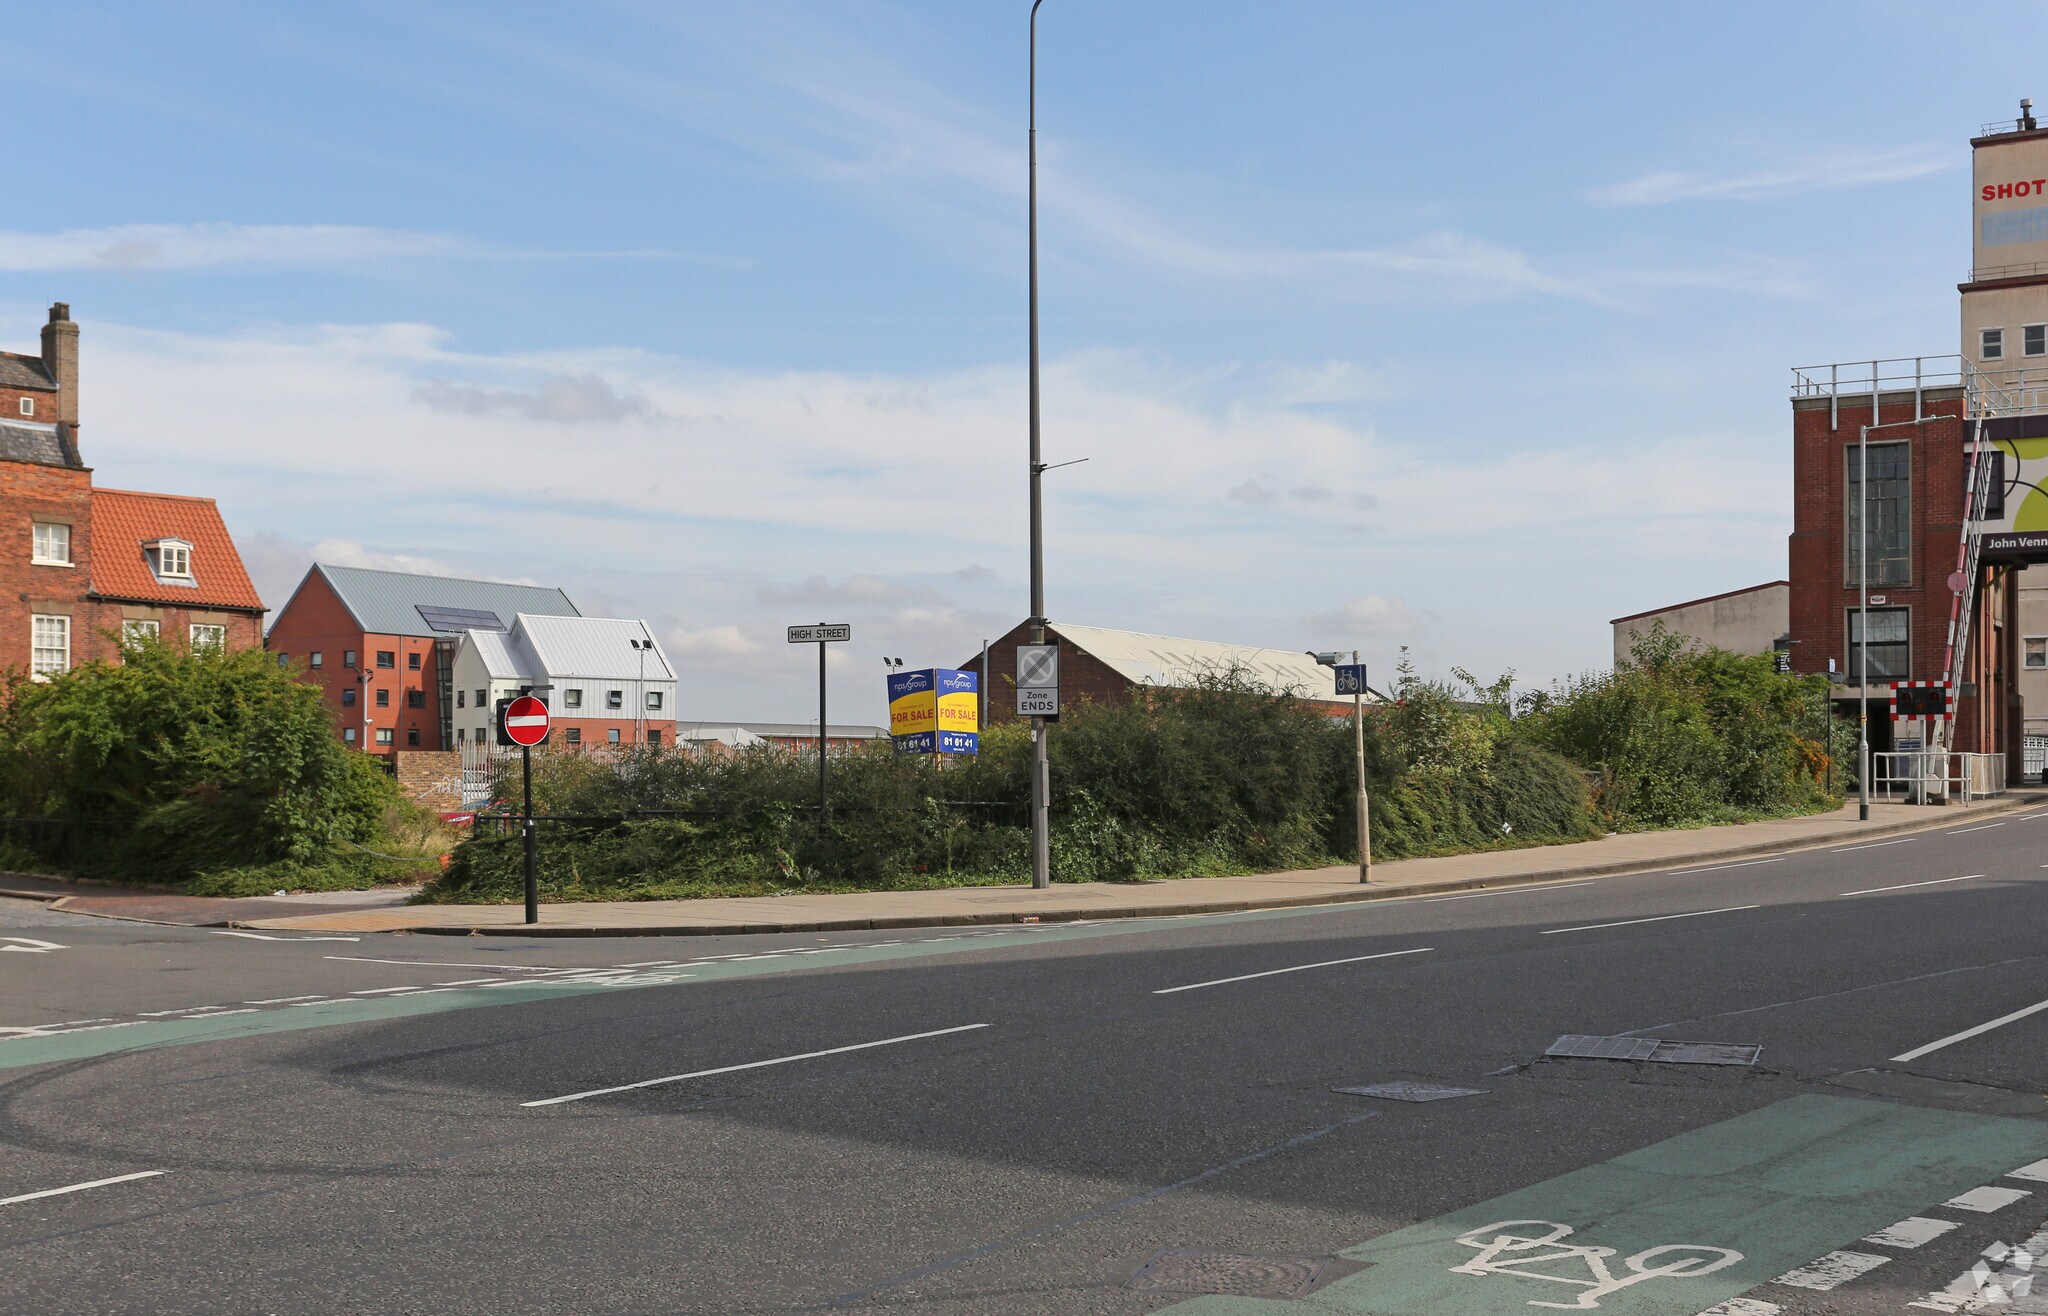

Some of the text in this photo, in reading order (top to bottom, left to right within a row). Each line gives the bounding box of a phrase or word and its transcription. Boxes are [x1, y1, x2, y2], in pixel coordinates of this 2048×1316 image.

[1989, 537, 2048, 549] John Venn
[791, 628, 847, 639] HIGH STREET
[1022, 701, 1054, 711] ENDS
[892, 709, 933, 723] FOR SALE
[940, 708, 976, 720] FOR SALE
[921, 738, 930, 747] 41
[944, 737, 973, 748] 81 61 41
